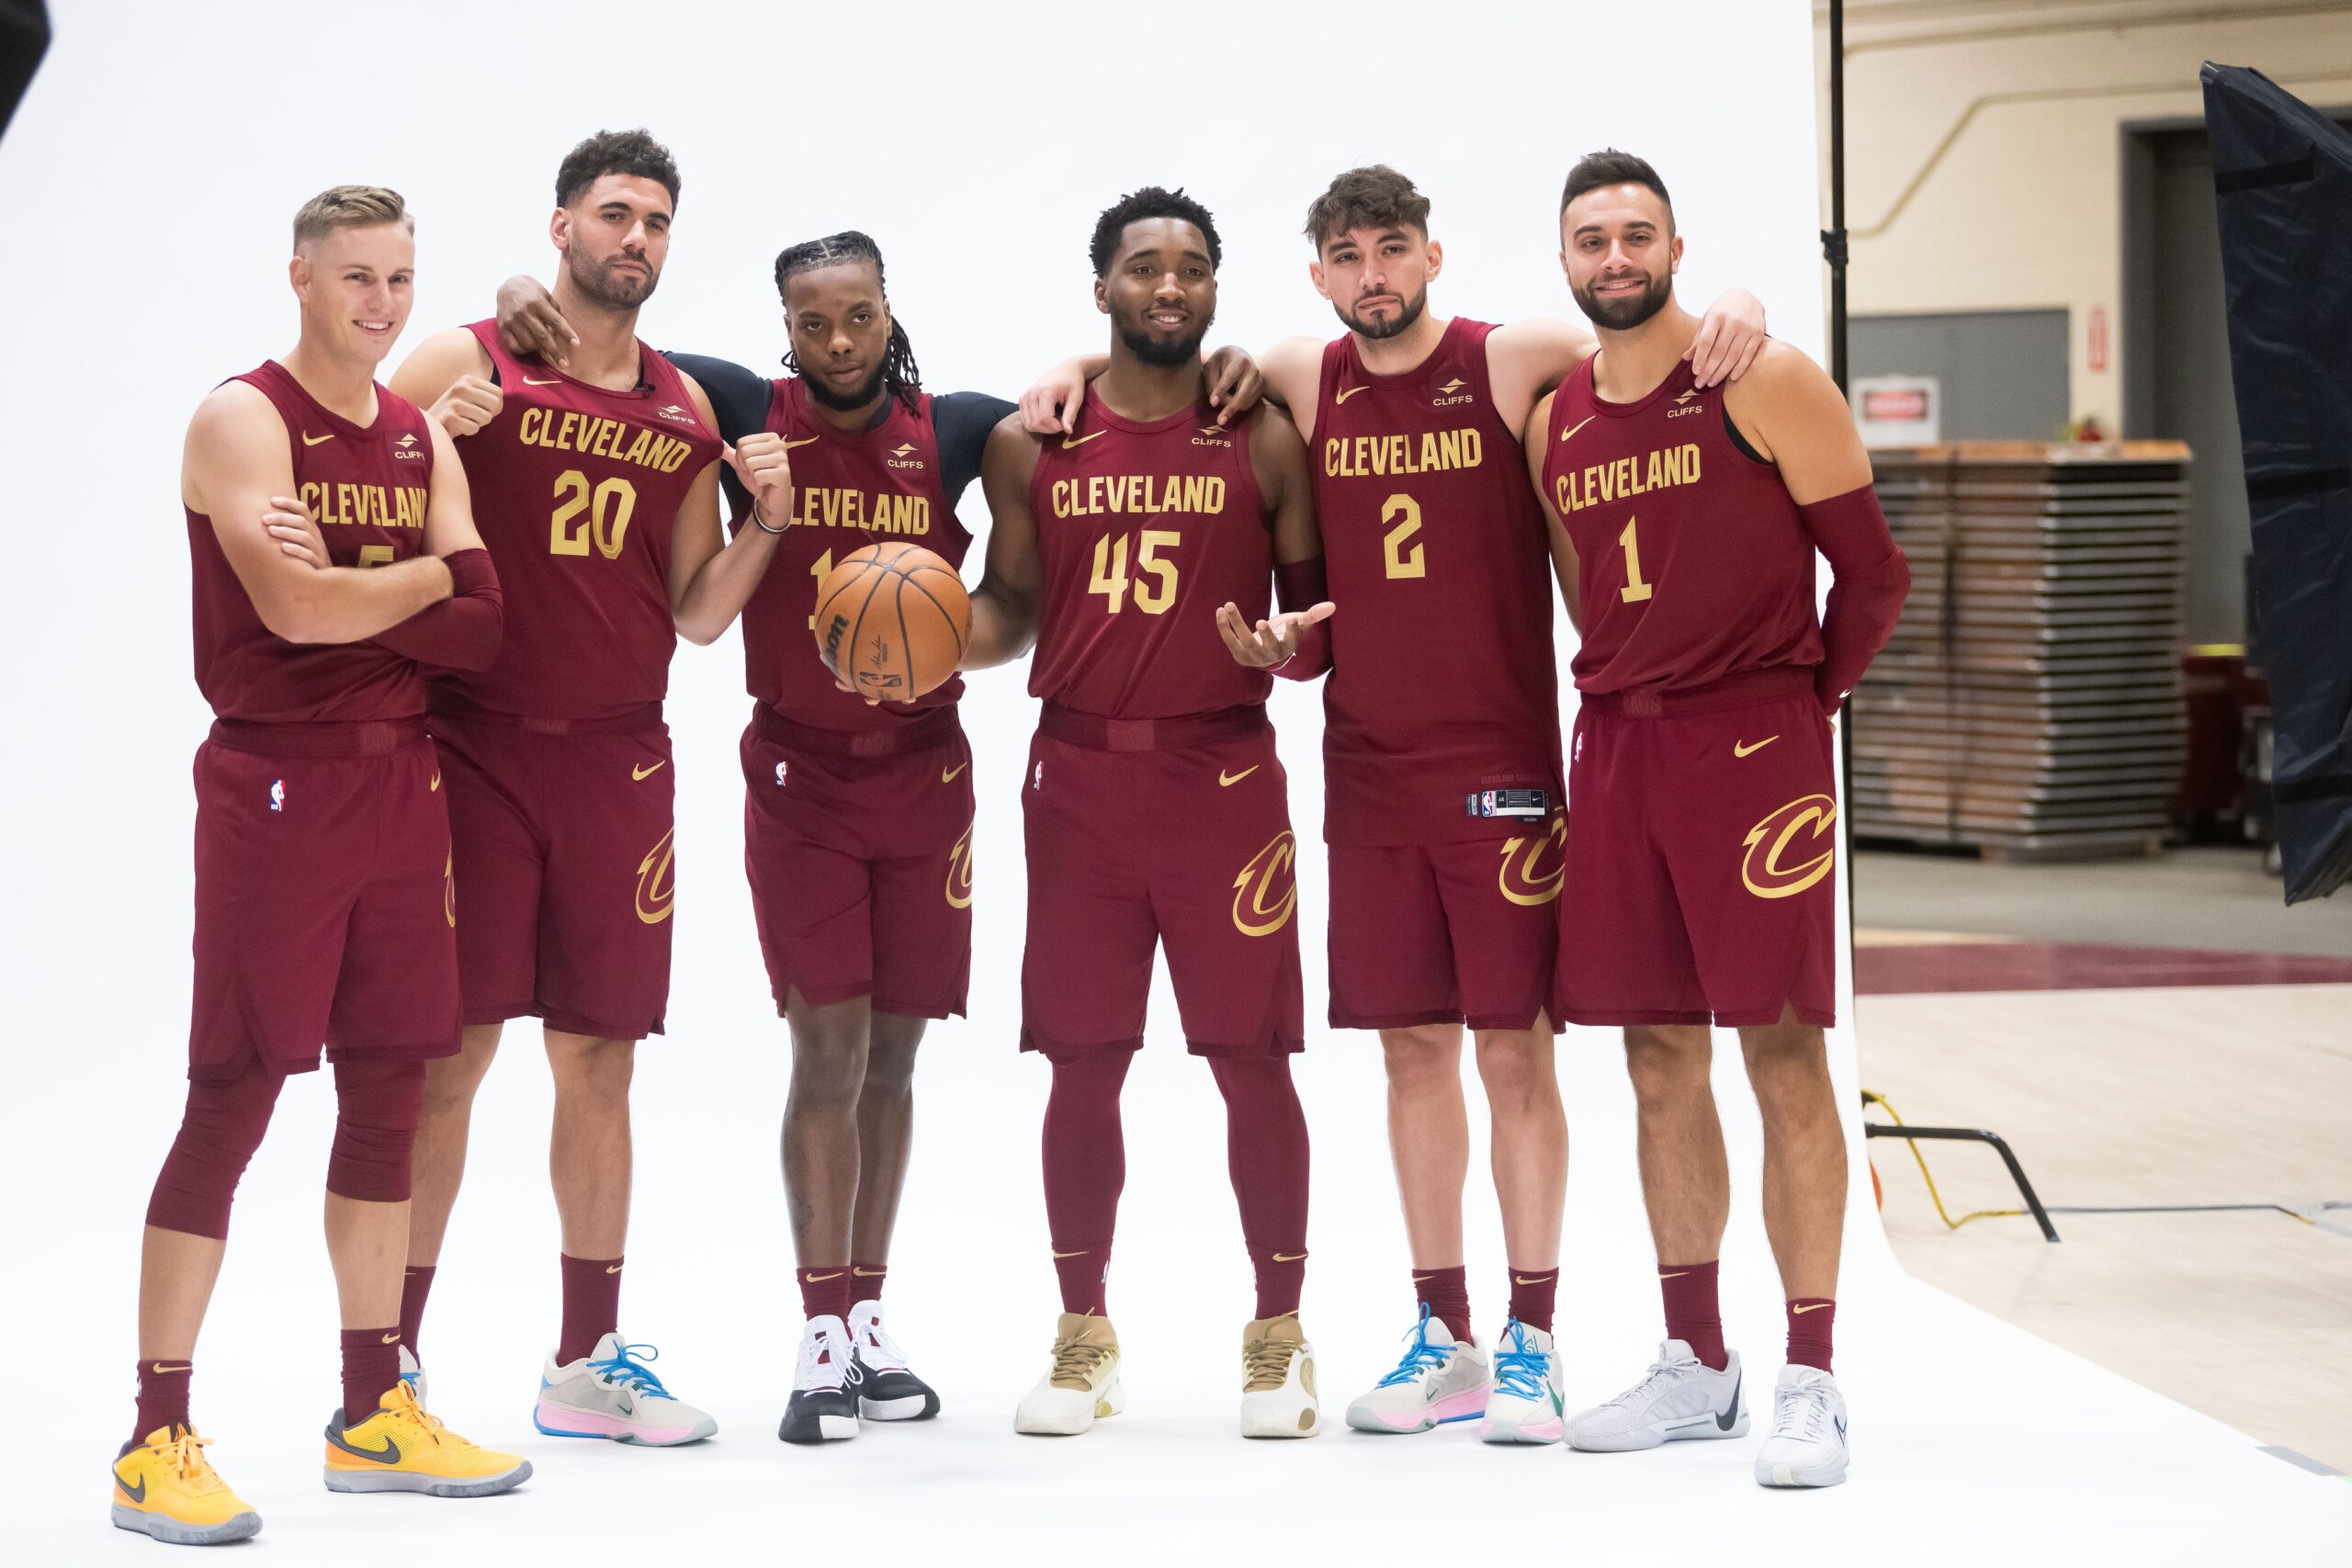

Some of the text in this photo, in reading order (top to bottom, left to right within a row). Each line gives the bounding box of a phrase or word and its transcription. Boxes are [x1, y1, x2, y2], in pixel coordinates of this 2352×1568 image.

[659, 412, 695, 424] CLIFFS
[1433, 395, 1474, 406] CLIFFS
[1667, 406, 1702, 418] CLIFFS
[519, 408, 692, 473] CLEVELAND
[888, 459, 924, 469] CLIFFS
[1192, 437, 1232, 448] CLIFFS
[1326, 428, 1483, 477] CLEVELAND
[1052, 475, 1226, 519] CLEVELAND
[1555, 443, 1702, 515] CLEVELAND
[550, 469, 638, 560] 20
[790, 487, 930, 536] LEVELAND
[1381, 493, 1426, 580] 2
[1619, 515, 1653, 604] 1
[1088, 530, 1182, 615] 45
